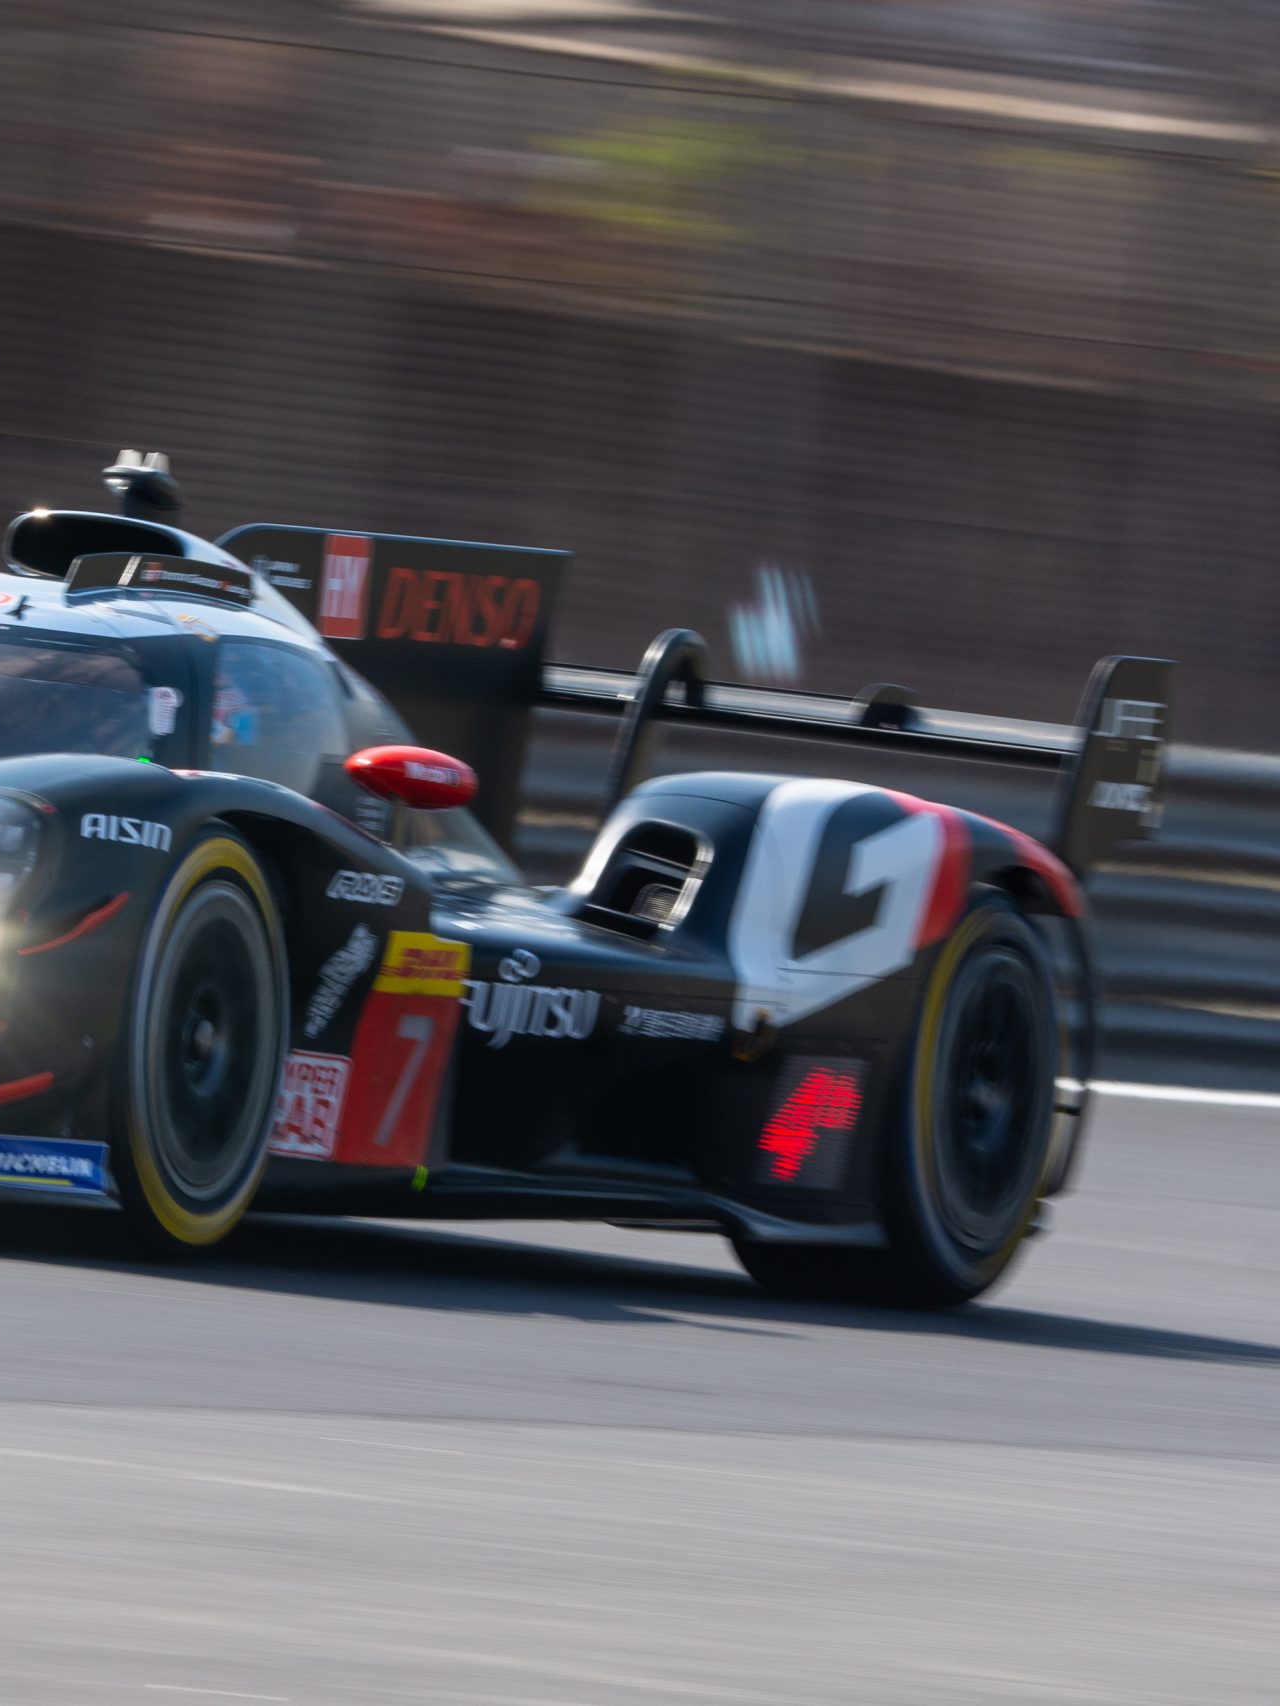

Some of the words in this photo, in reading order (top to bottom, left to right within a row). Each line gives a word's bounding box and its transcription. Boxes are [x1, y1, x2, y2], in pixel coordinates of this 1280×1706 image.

[375, 567, 542, 650] DENSO
[80, 813, 172, 853] AISIN
[374, 1014, 435, 1147] 7
